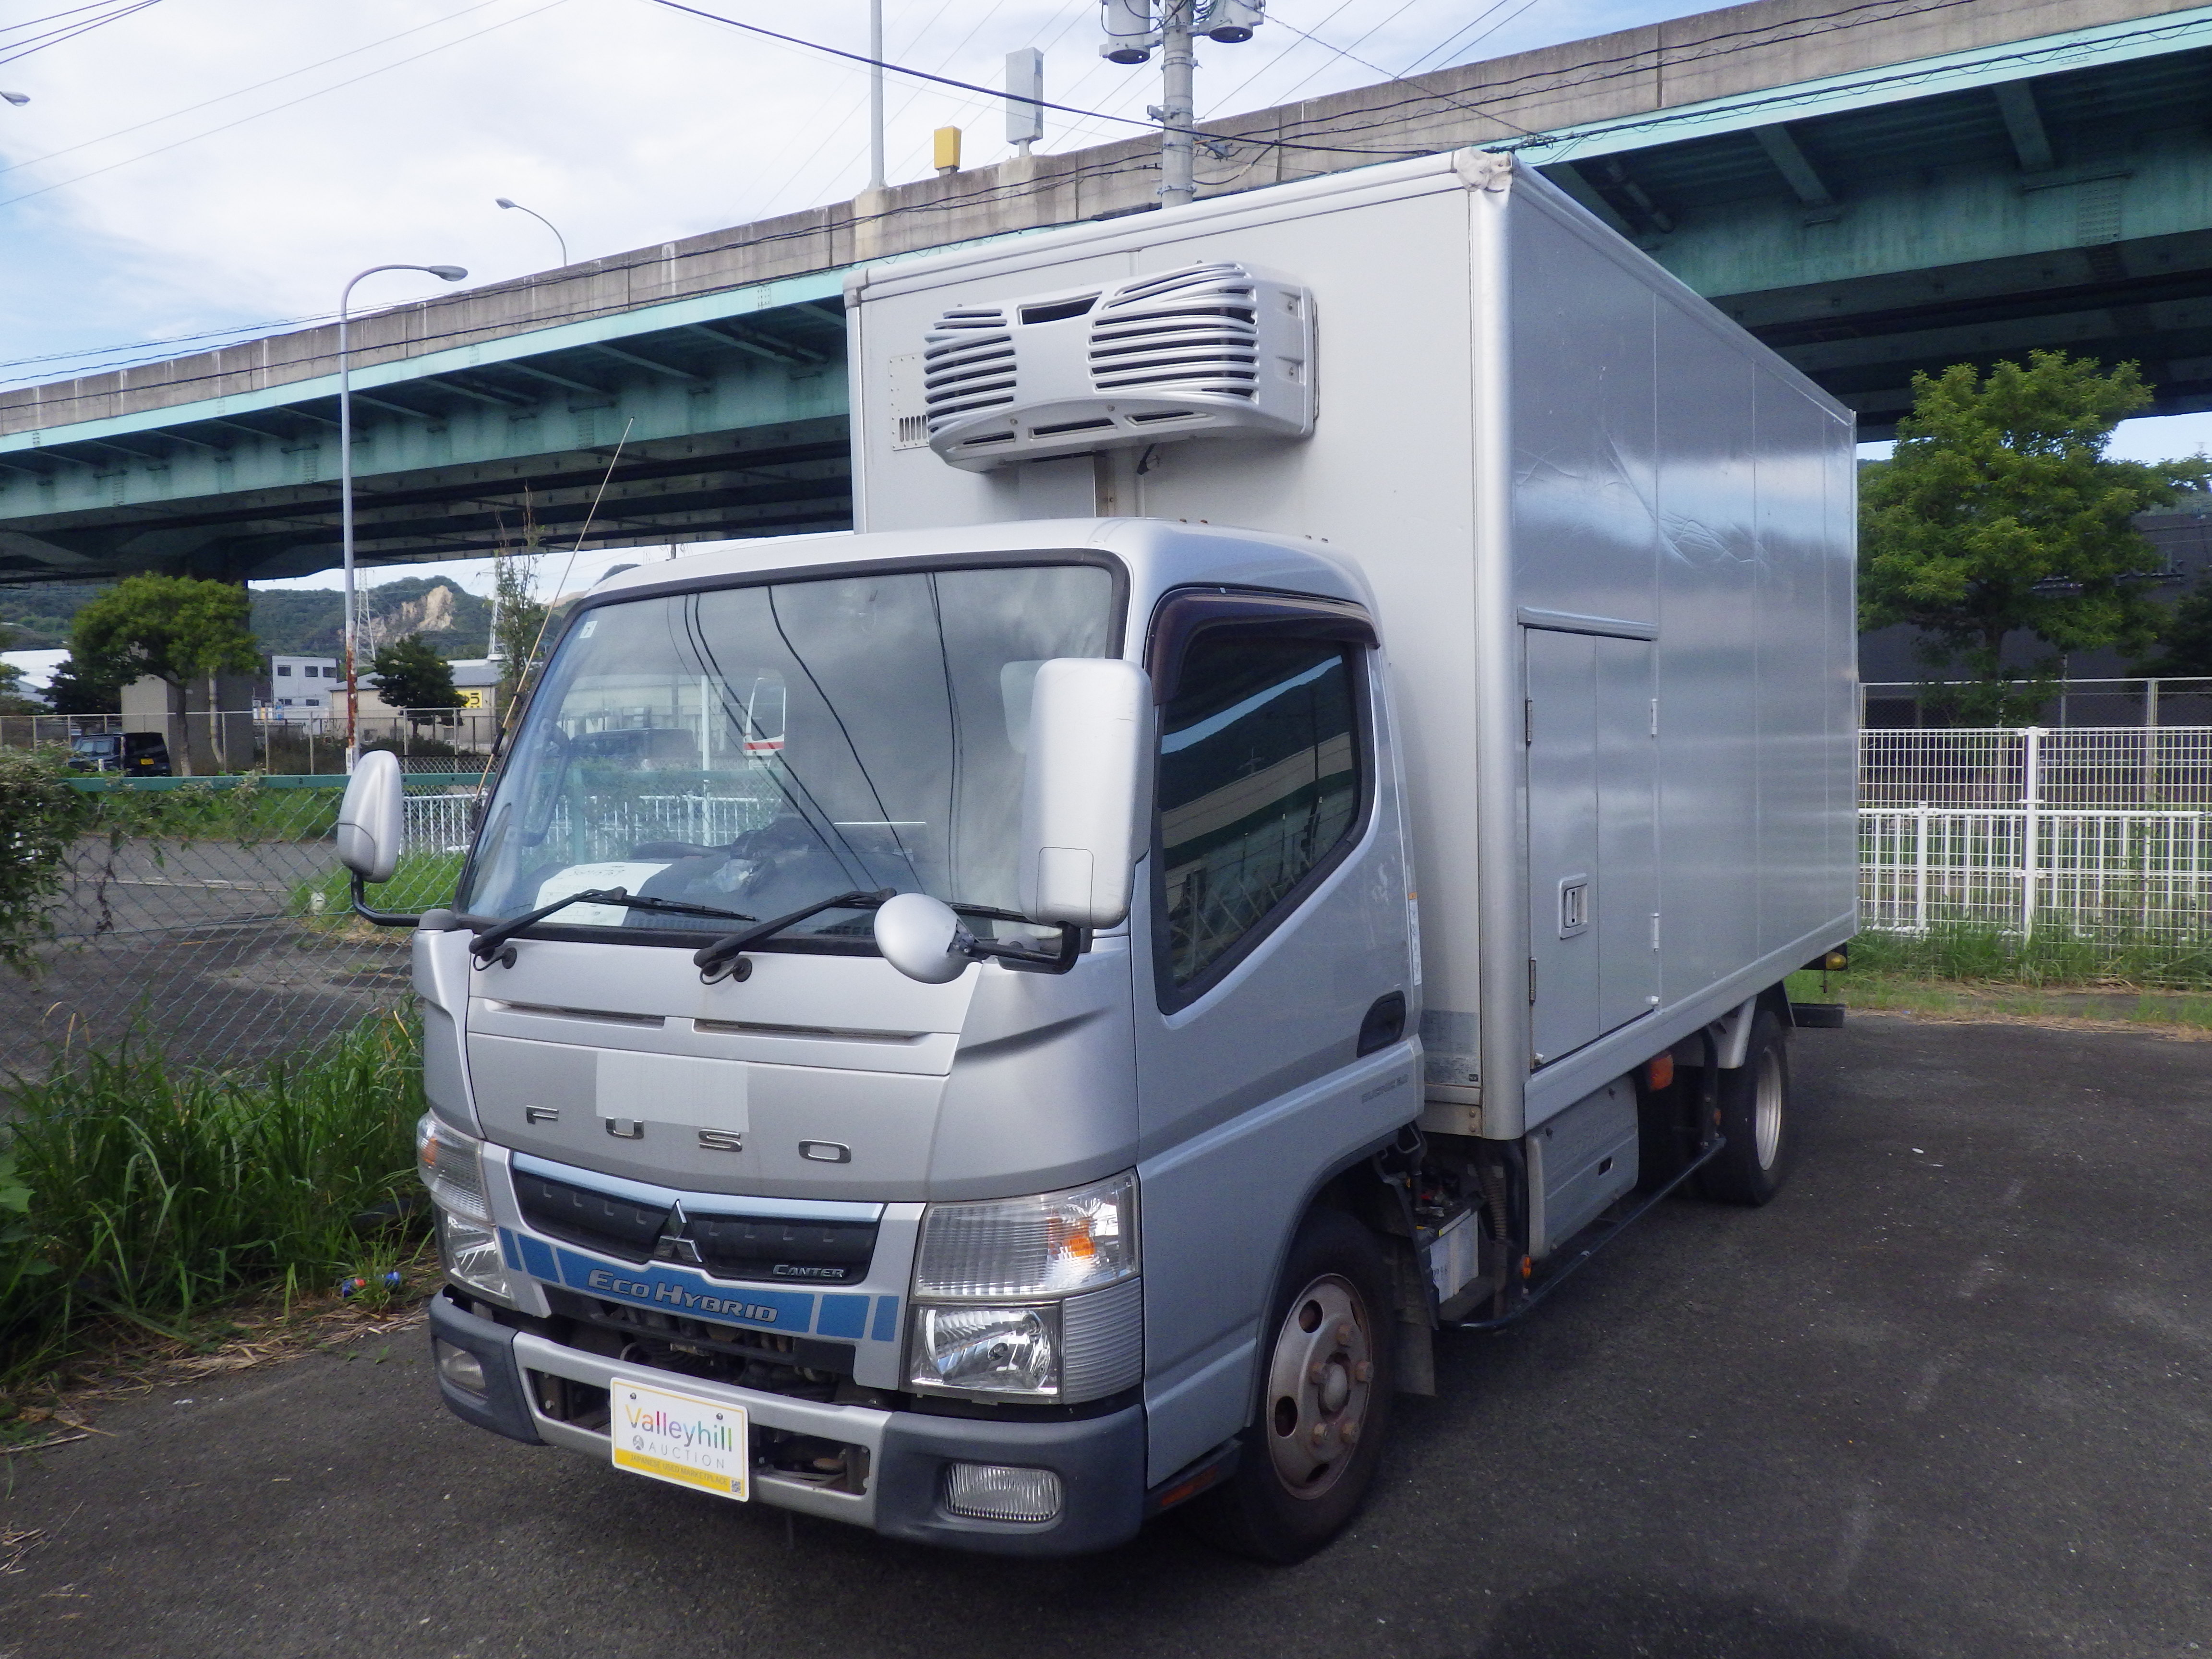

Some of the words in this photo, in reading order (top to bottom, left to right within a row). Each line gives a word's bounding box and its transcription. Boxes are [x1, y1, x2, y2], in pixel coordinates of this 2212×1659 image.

[526, 1105, 852, 1164] FUSO
[772, 1264, 844, 1278] CANTER
[625, 1404, 733, 1452] Valleyhill
[630, 1454, 661, 1468] JAPANESE
[662, 1463, 679, 1473] USED
[681, 1467, 727, 1485] MARKETPLACE
[649, 1442, 724, 1468] AUCTION
